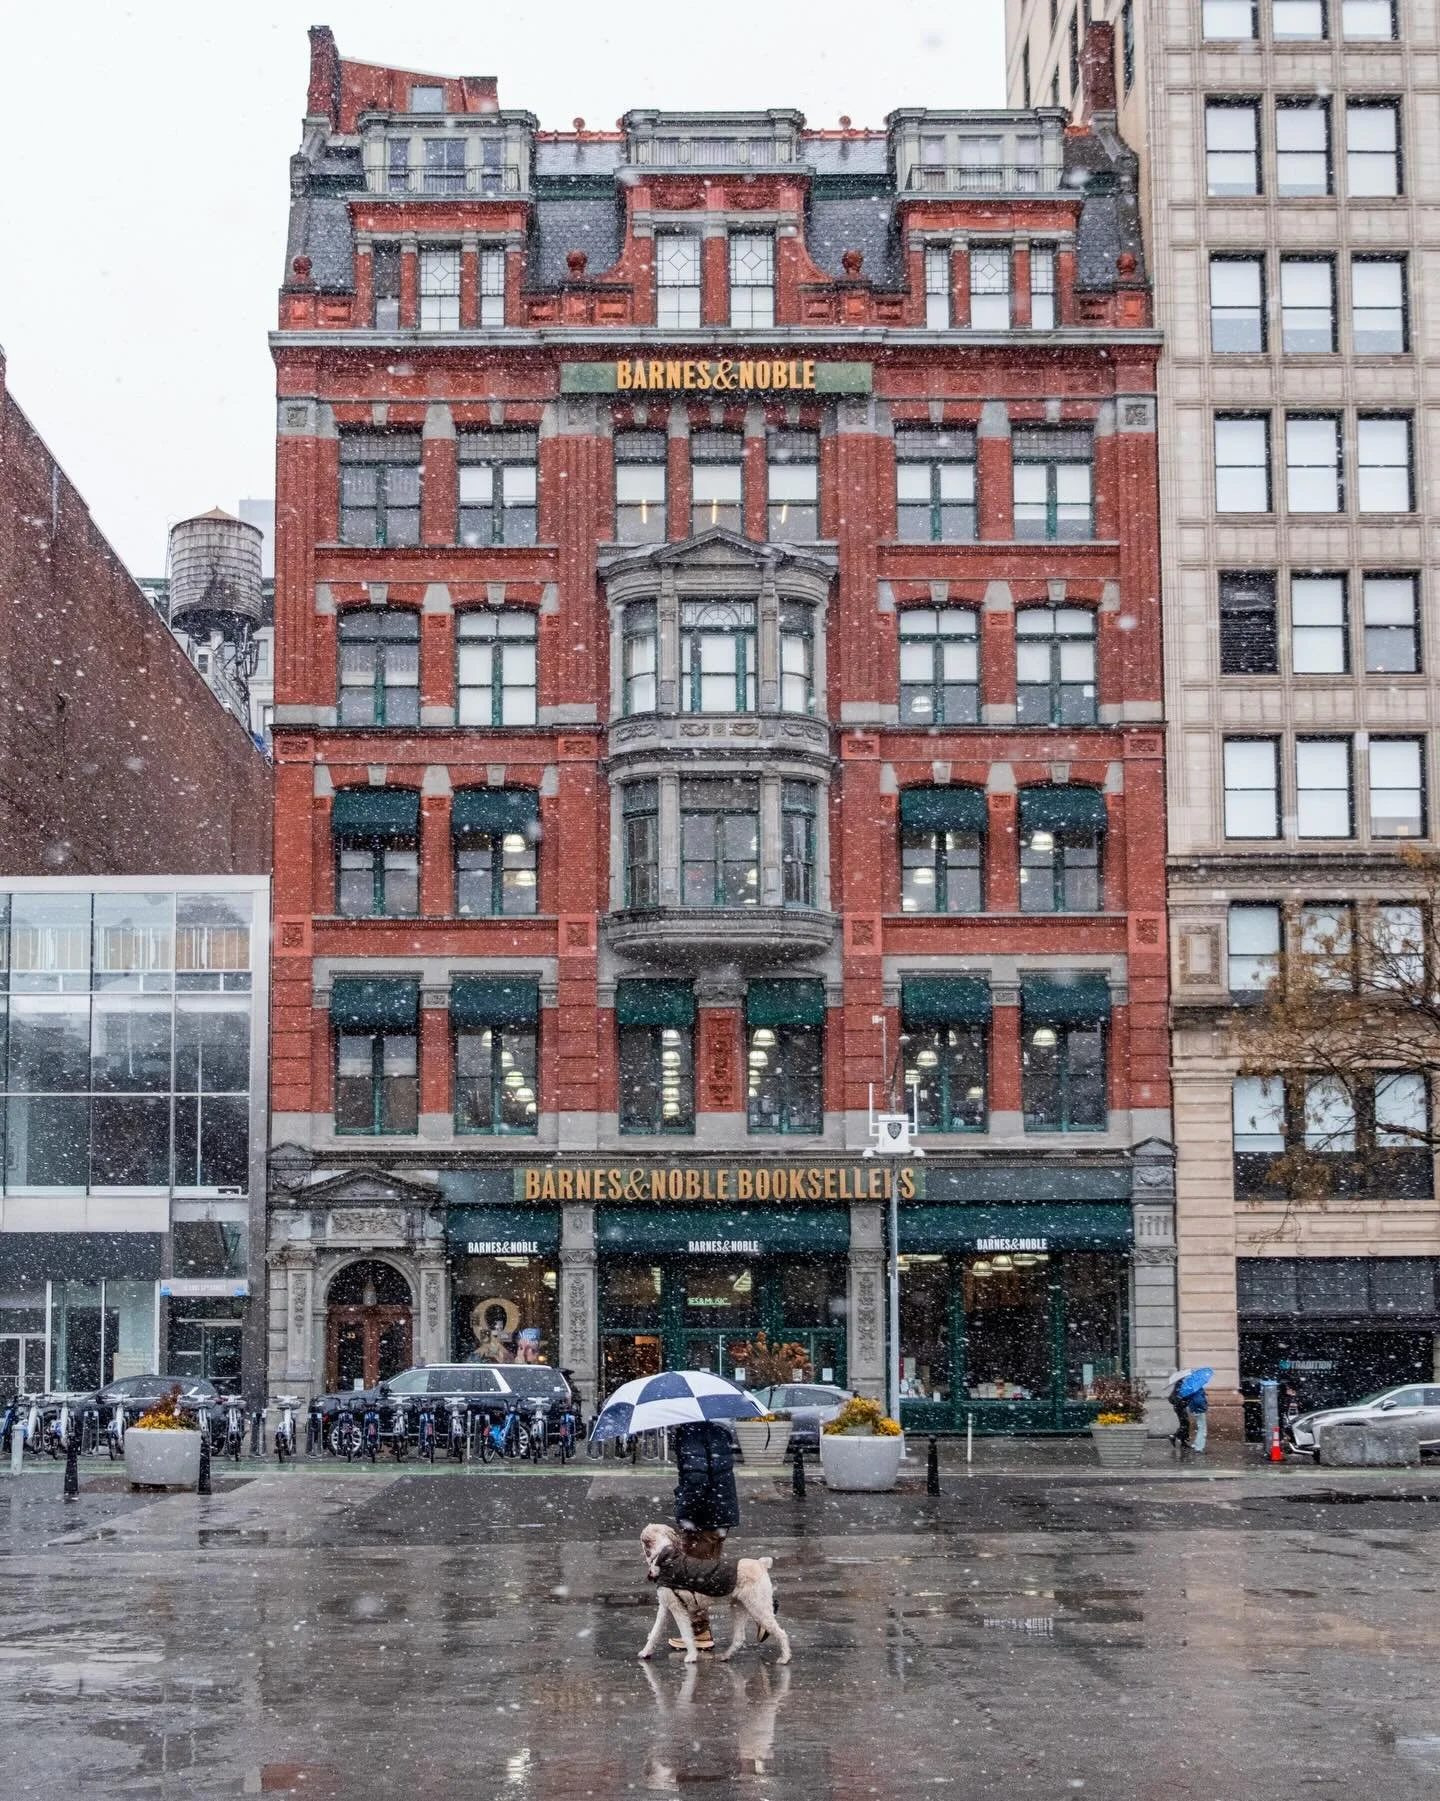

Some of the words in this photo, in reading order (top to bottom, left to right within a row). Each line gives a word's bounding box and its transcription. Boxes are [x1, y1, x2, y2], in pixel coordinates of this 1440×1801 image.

[617, 360, 815, 390] BARNES&NOBLE
[526, 1167, 729, 1200] BARNES&NOBLE
[468, 1241, 538, 1253] BARNES&NOBLE
[688, 1240, 759, 1253] BARNES&NOBLE
[977, 1238, 1048, 1250] BARNES&NOBLE
